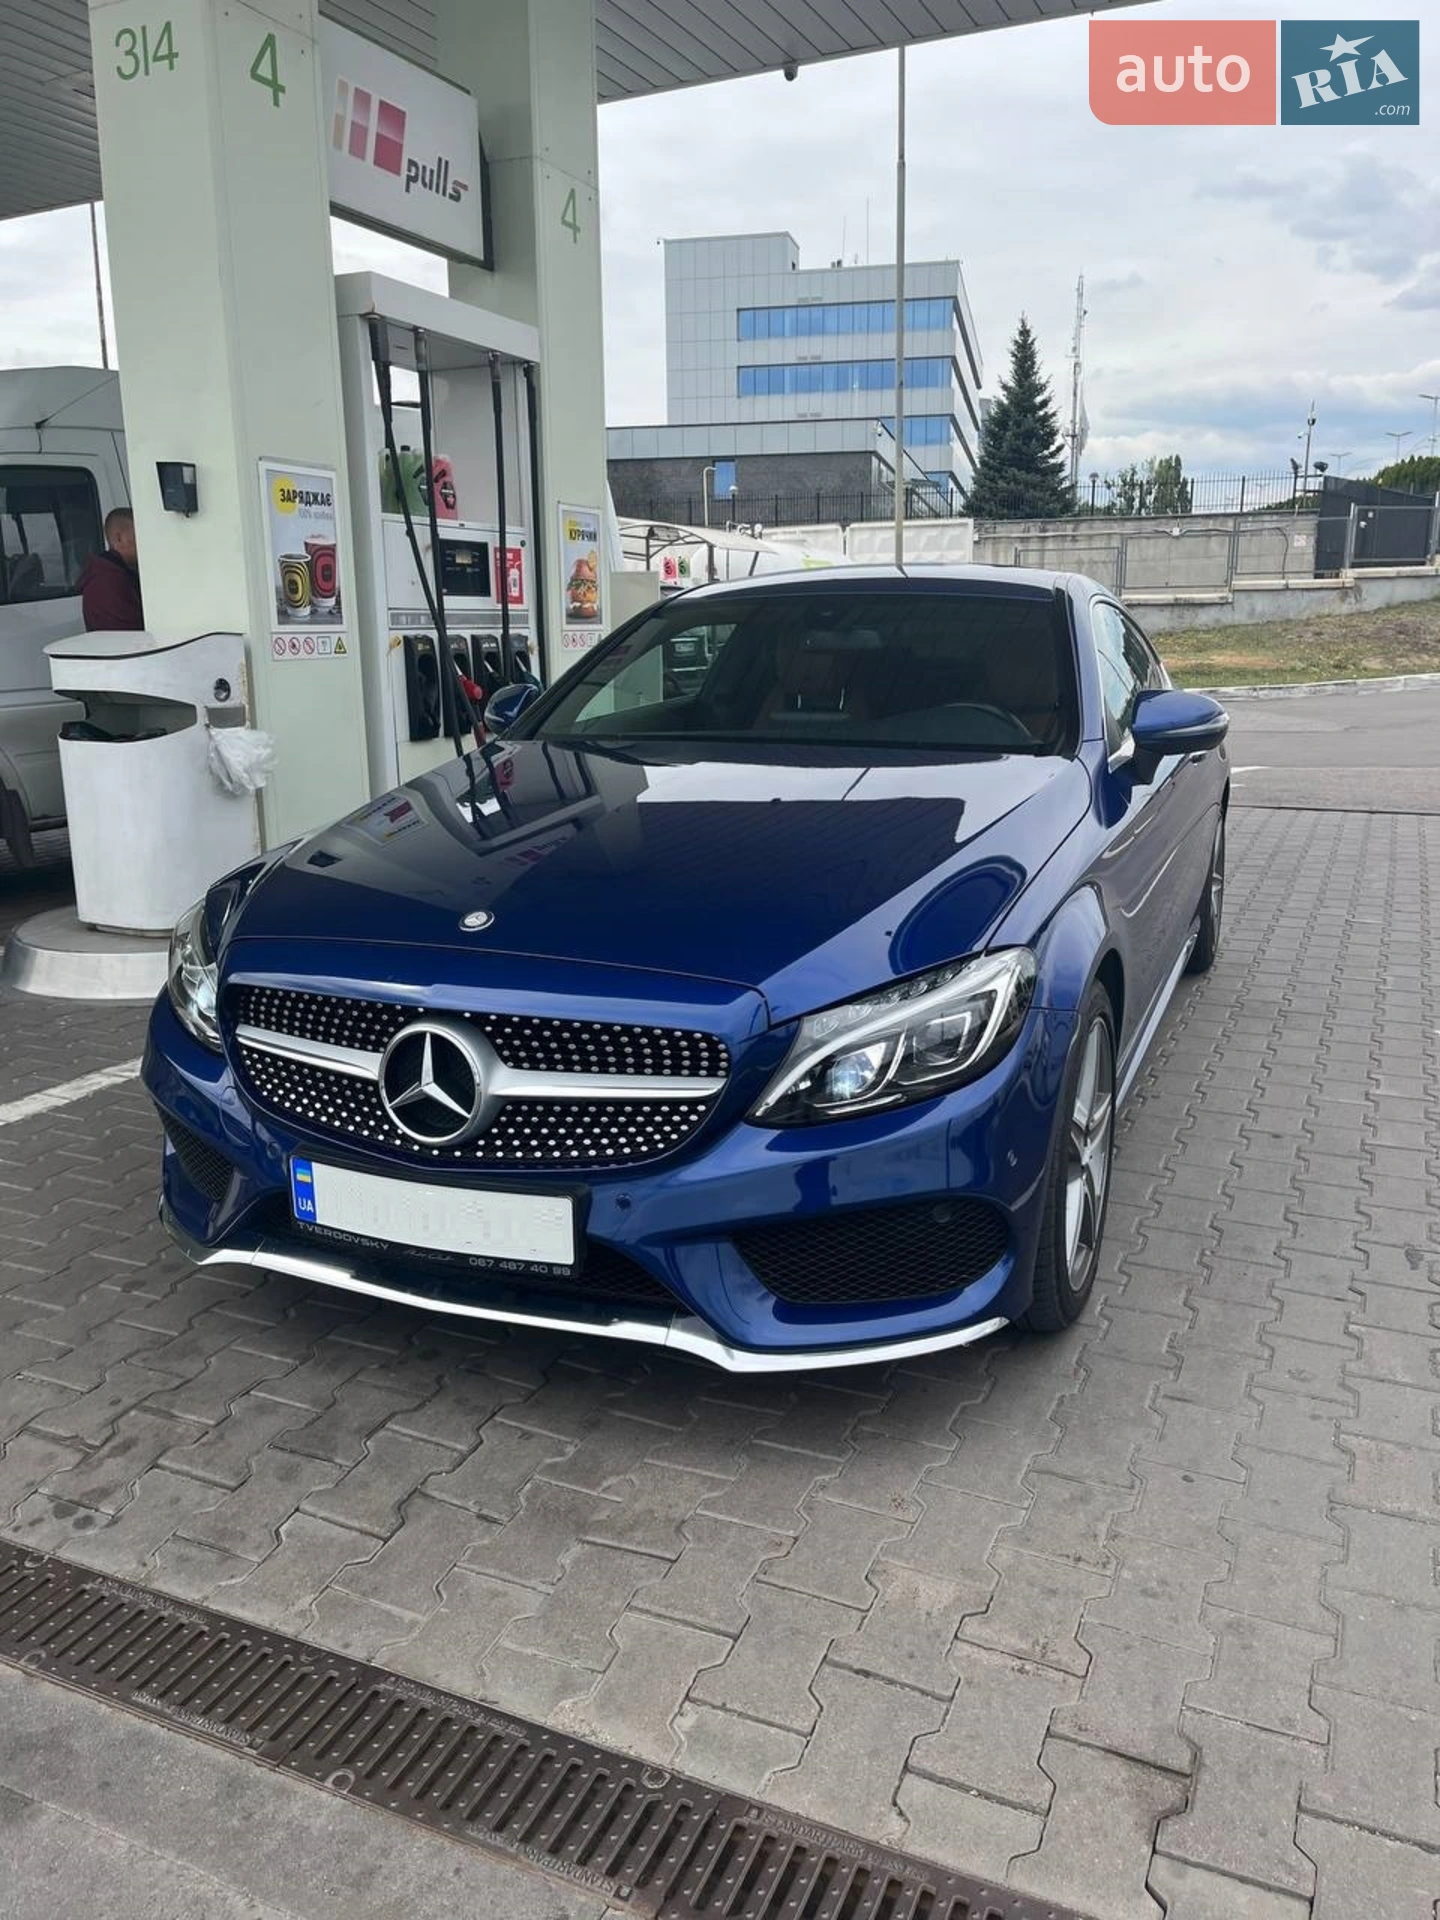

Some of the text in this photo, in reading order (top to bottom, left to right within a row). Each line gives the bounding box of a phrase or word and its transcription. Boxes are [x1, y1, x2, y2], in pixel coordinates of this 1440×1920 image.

[250, 32, 286, 108] 4
[405, 156, 469, 203] pulls
[561, 188, 581, 244] 4
[298, 1196, 315, 1213] UA
